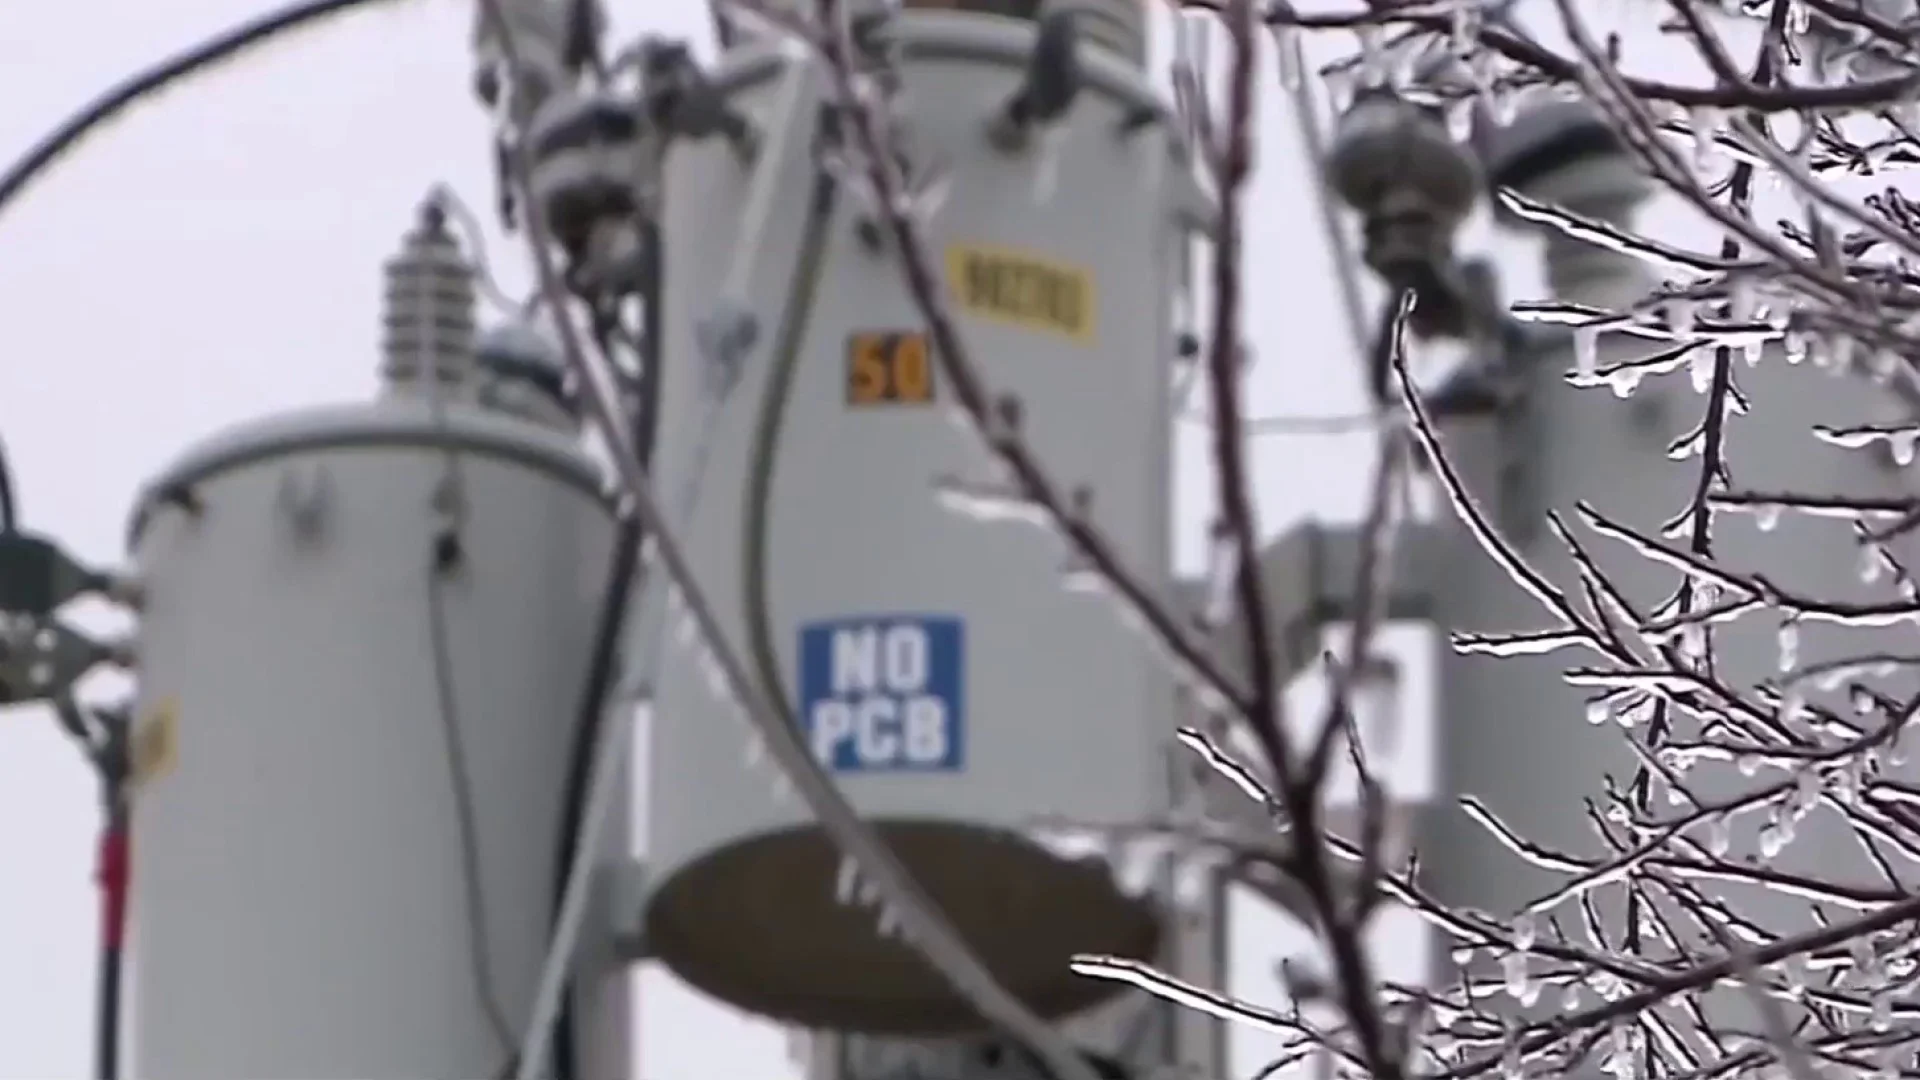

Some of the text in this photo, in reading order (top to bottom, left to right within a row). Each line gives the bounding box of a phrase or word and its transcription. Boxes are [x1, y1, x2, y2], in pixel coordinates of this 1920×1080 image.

[850, 335, 930, 402] 50
[831, 625, 929, 692] NO
[812, 697, 947, 765] PCB
